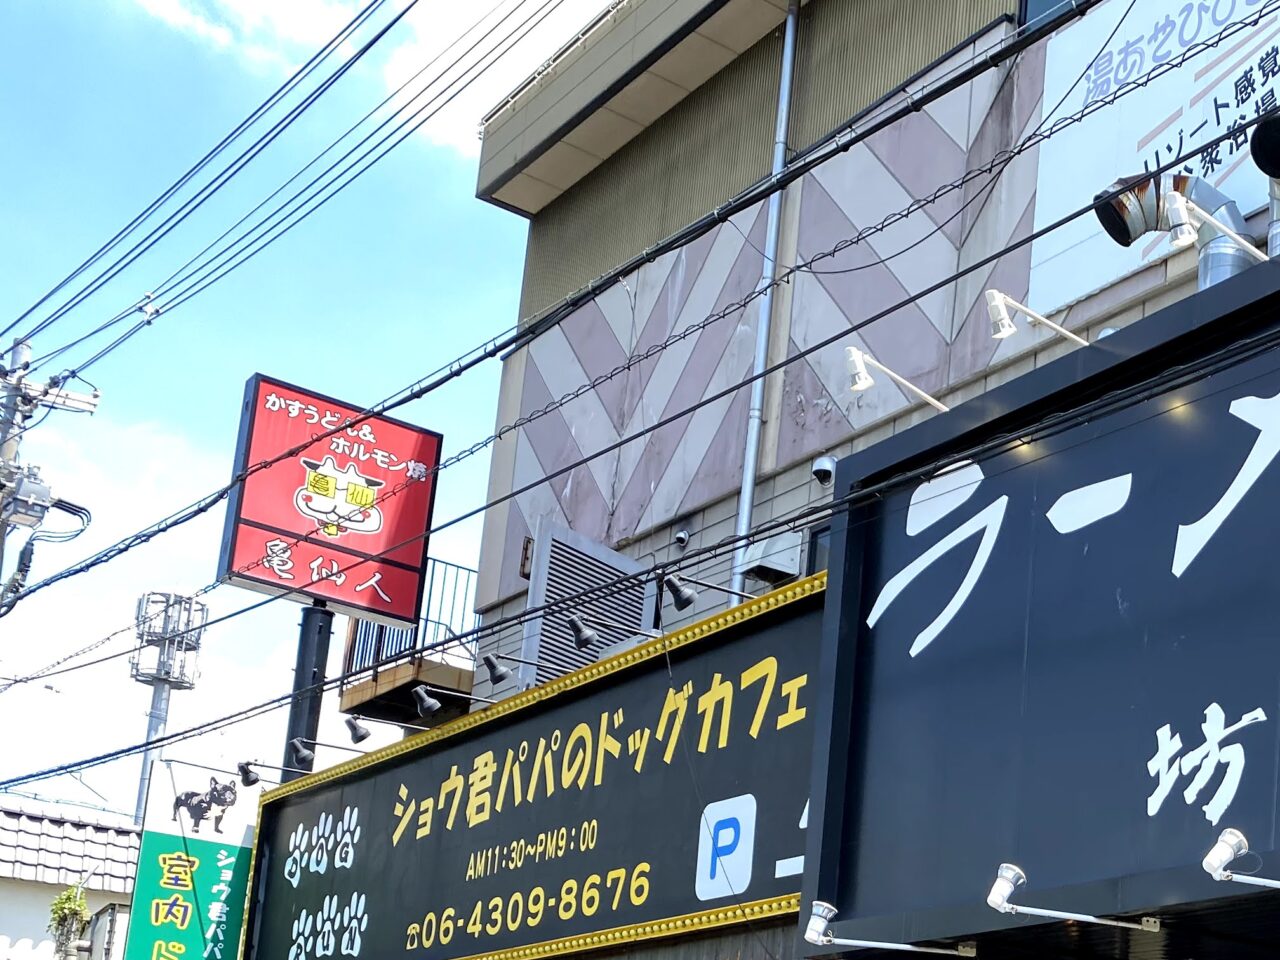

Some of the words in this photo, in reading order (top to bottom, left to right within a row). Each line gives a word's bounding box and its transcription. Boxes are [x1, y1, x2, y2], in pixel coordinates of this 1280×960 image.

[1178, 87, 1278, 178] 衆浴場
[392, 656, 807, 846] ショウ君パパのドッグカフェ
[422, 863, 650, 949] 06-4309-8676
